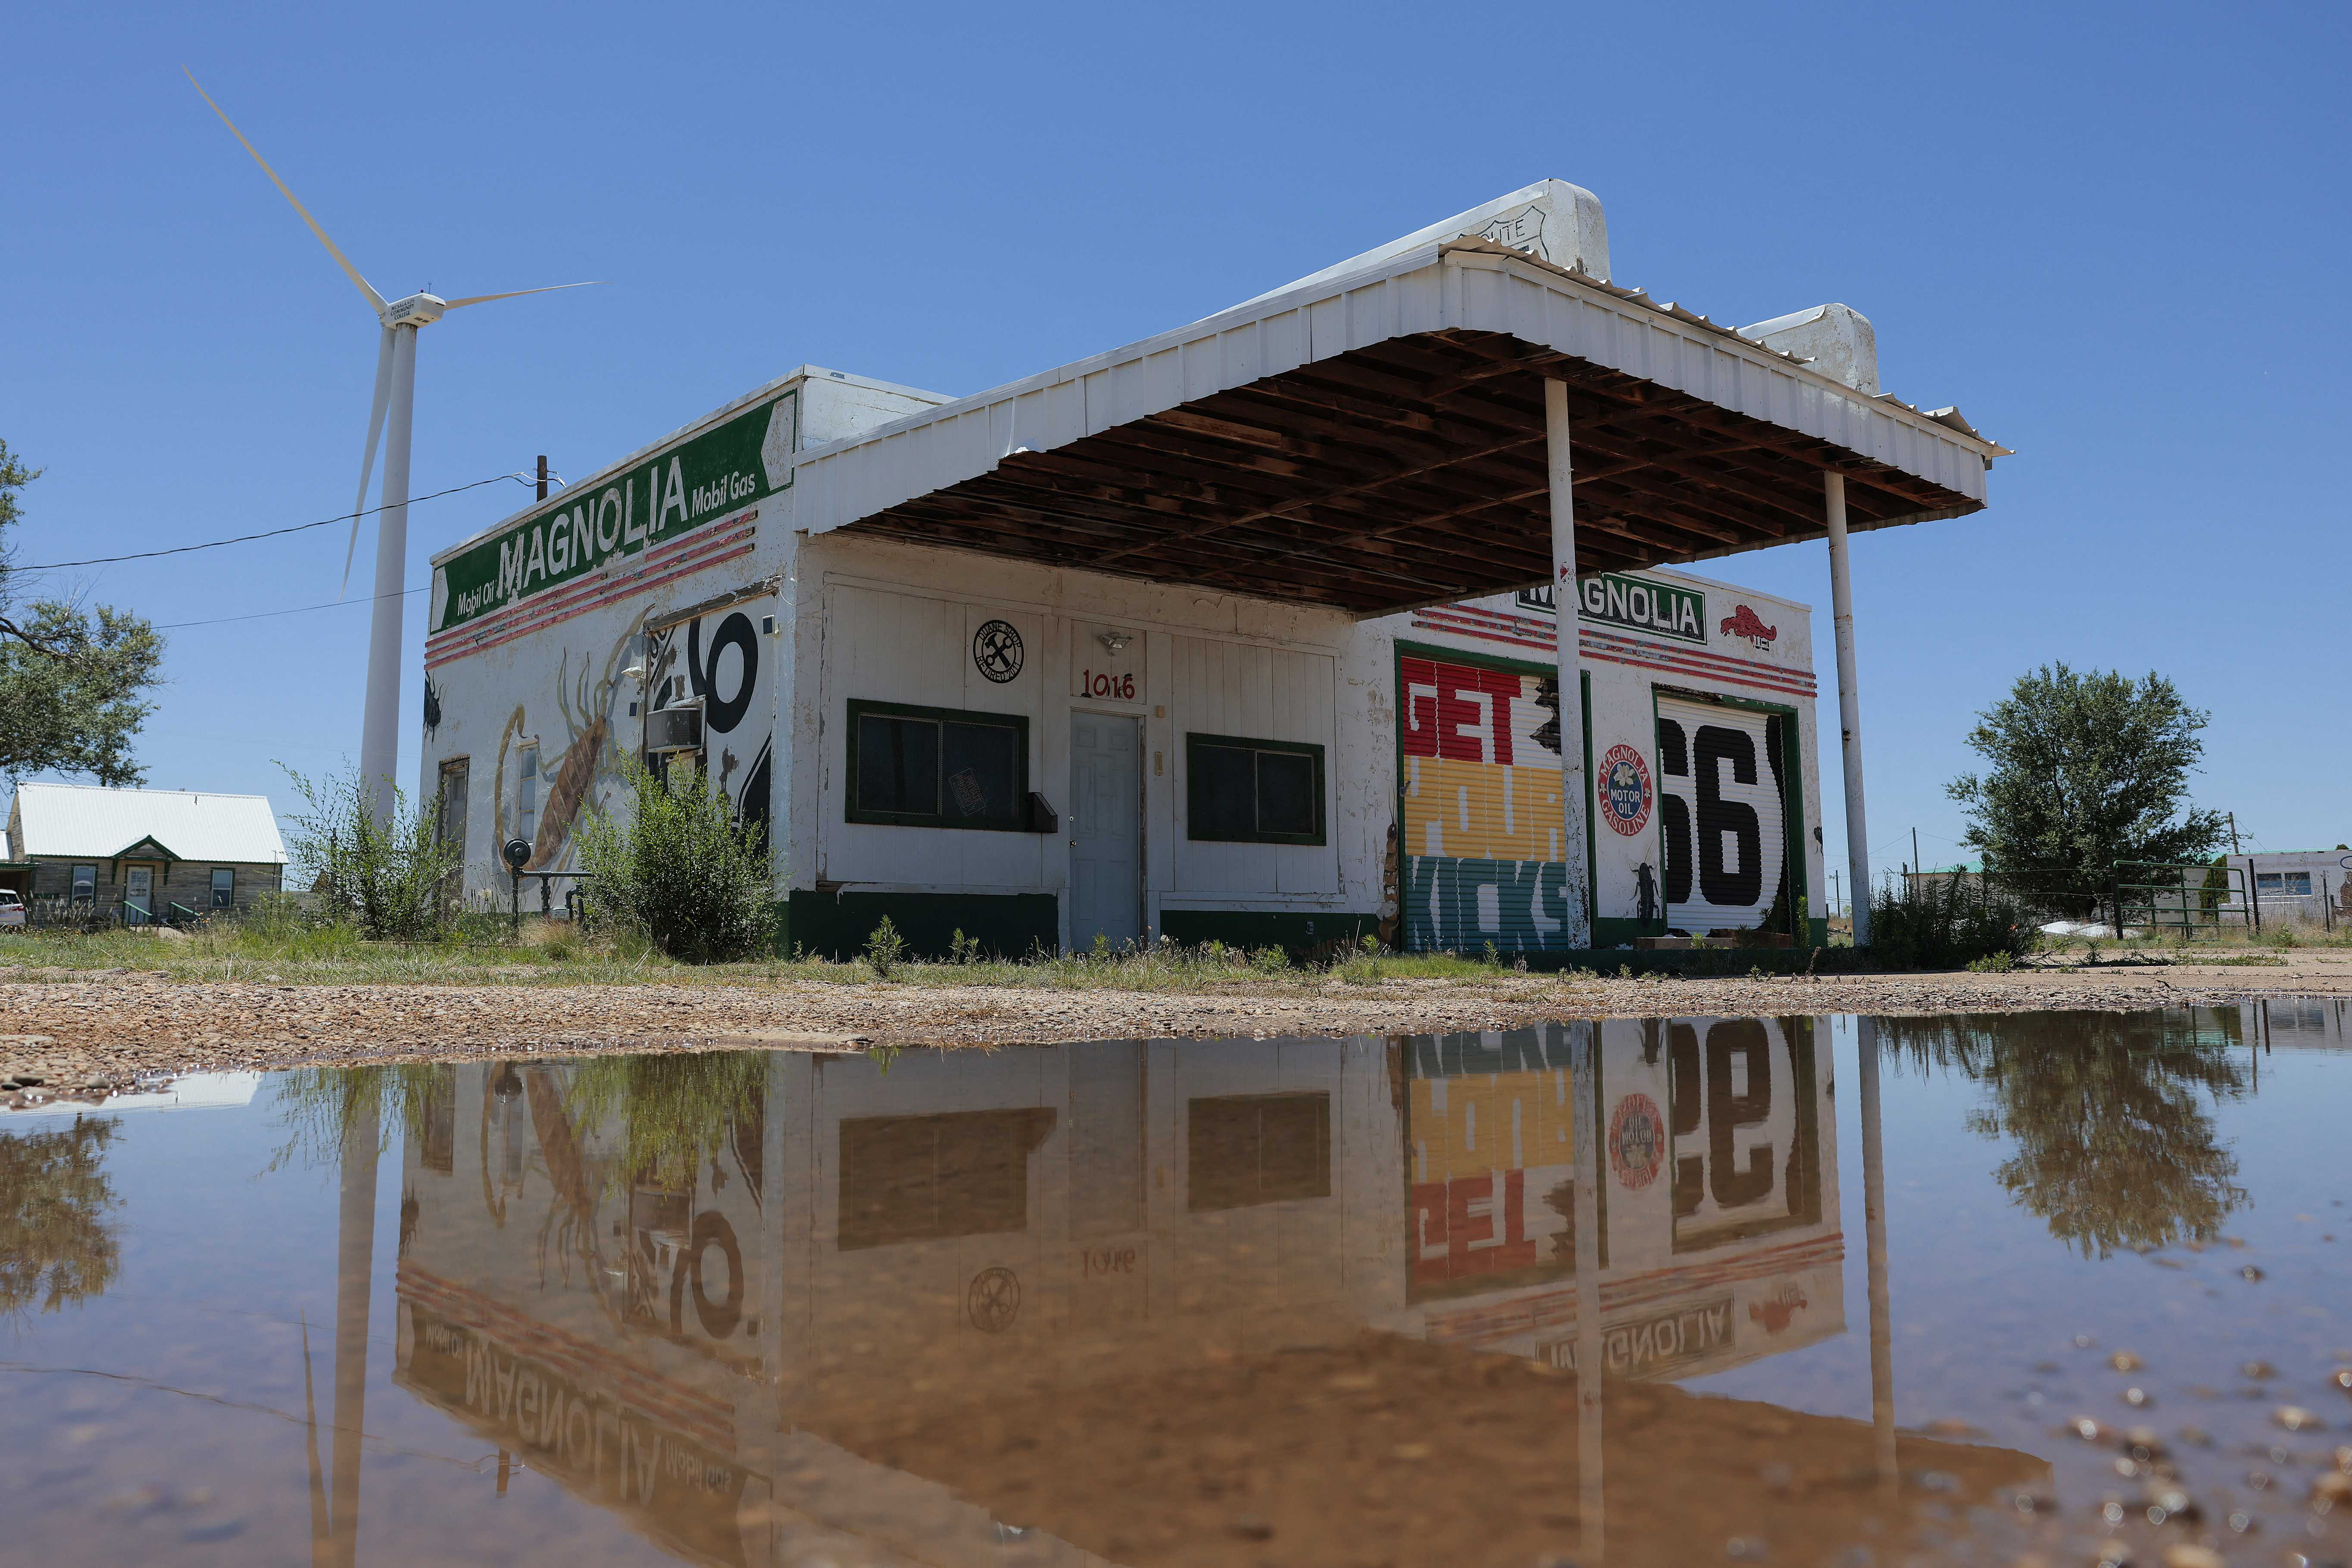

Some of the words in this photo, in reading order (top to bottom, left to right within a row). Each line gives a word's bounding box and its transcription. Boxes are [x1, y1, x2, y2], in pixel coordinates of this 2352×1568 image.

[390, 304, 414, 316] COMMUNITY
[394, 310, 410, 320] COLLEGE
[692, 475, 728, 518] Mobil
[730, 471, 756, 500] Gas
[497, 456, 688, 600] MAGNOLIA
[457, 585, 481, 616] Mobil
[483, 580, 494, 605] Oil
[978, 623, 1002, 640] DUANE
[1004, 625, 1021, 648] SHOP
[976, 656, 1006, 681] RETIRED
[1006, 661, 1021, 678] 2011
[1083, 669, 1135, 699] 1016
[1402, 656, 1523, 766] GET
[1600, 747, 1648, 784] MAGNOLIA
[1404, 756, 1565, 862] YOUR
[1611, 789, 1640, 803] MOTOR
[1618, 803, 1633, 815] OIL
[1602, 799, 1649, 834] GASOLINE
